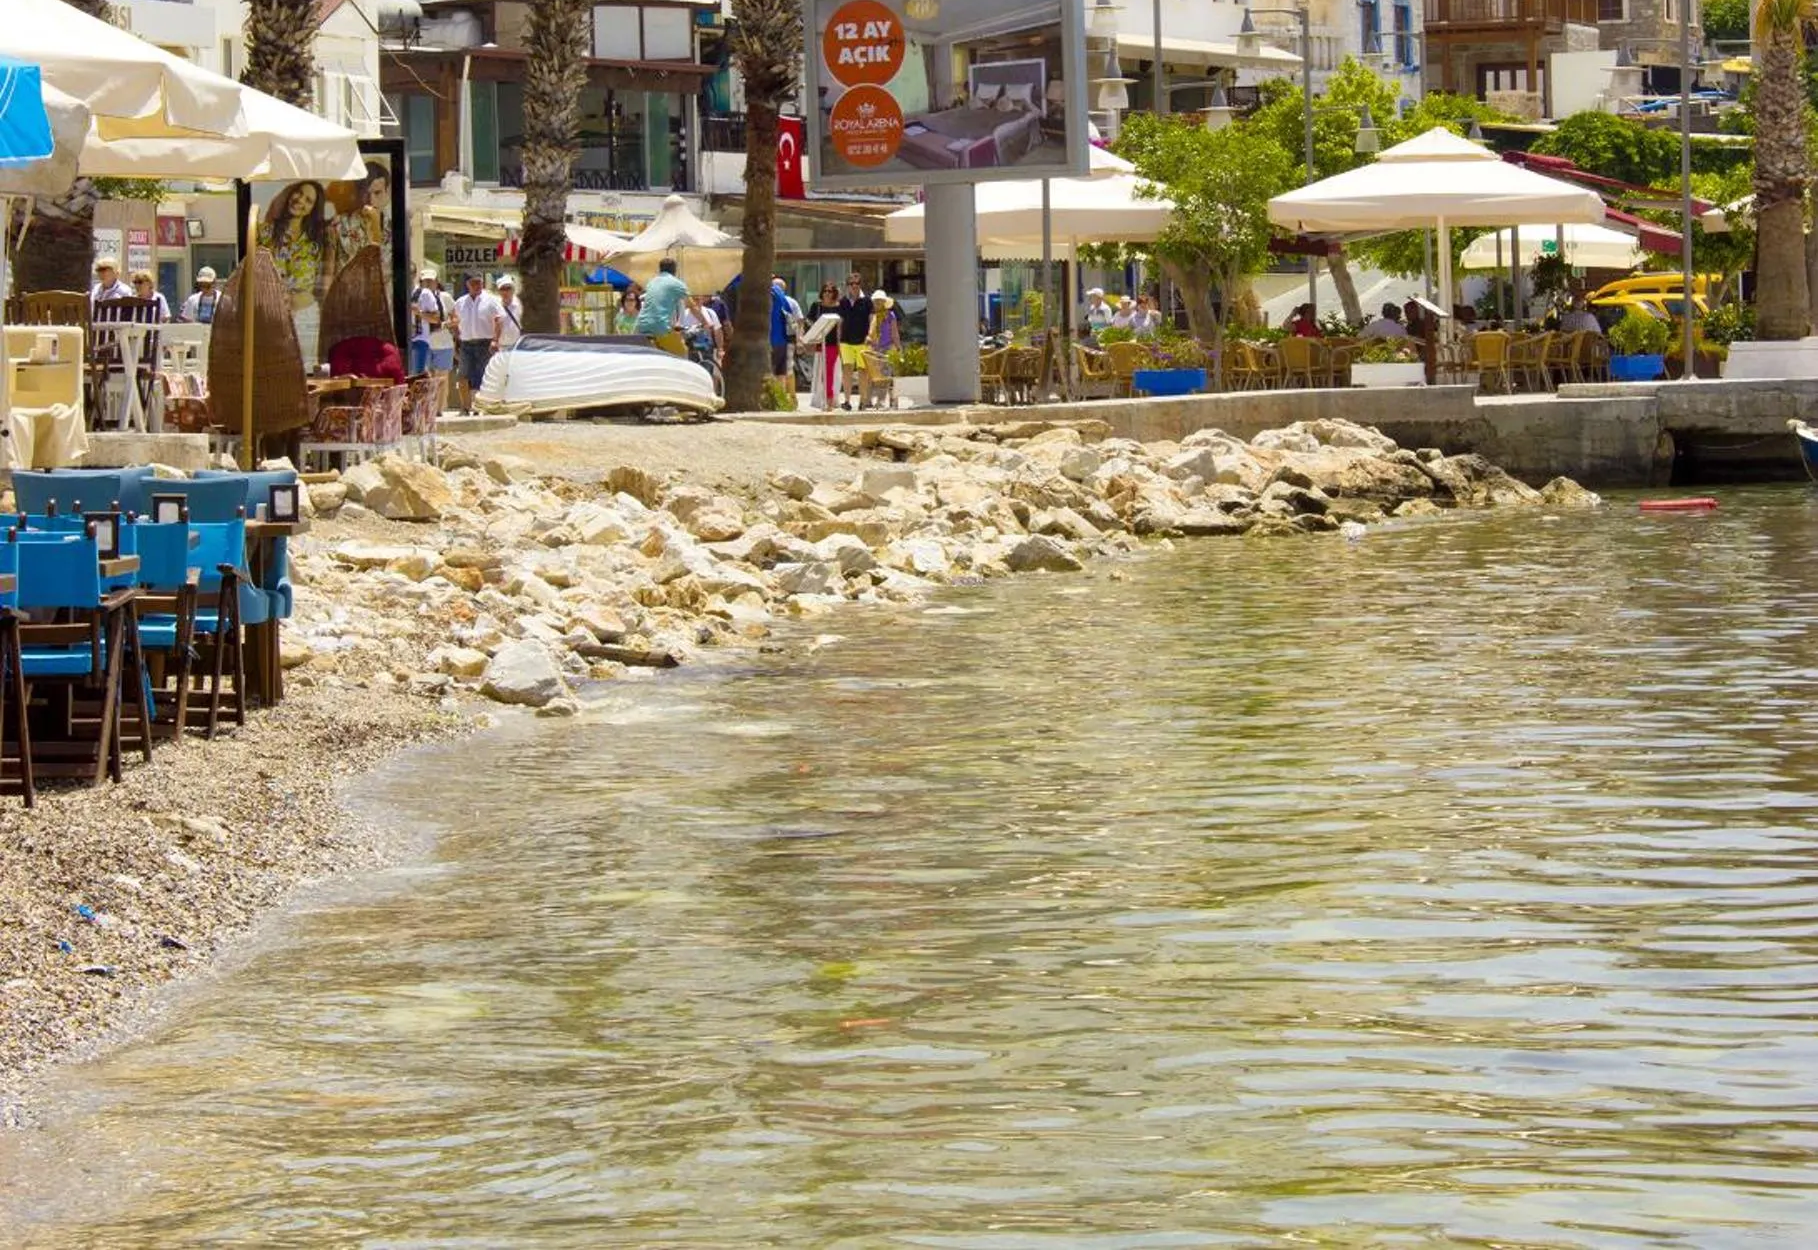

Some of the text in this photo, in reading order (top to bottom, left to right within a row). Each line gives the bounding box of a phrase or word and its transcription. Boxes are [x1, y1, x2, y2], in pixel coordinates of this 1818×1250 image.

[834, 20, 892, 40] 12 AY
[838, 45, 891, 69] AÇIK
